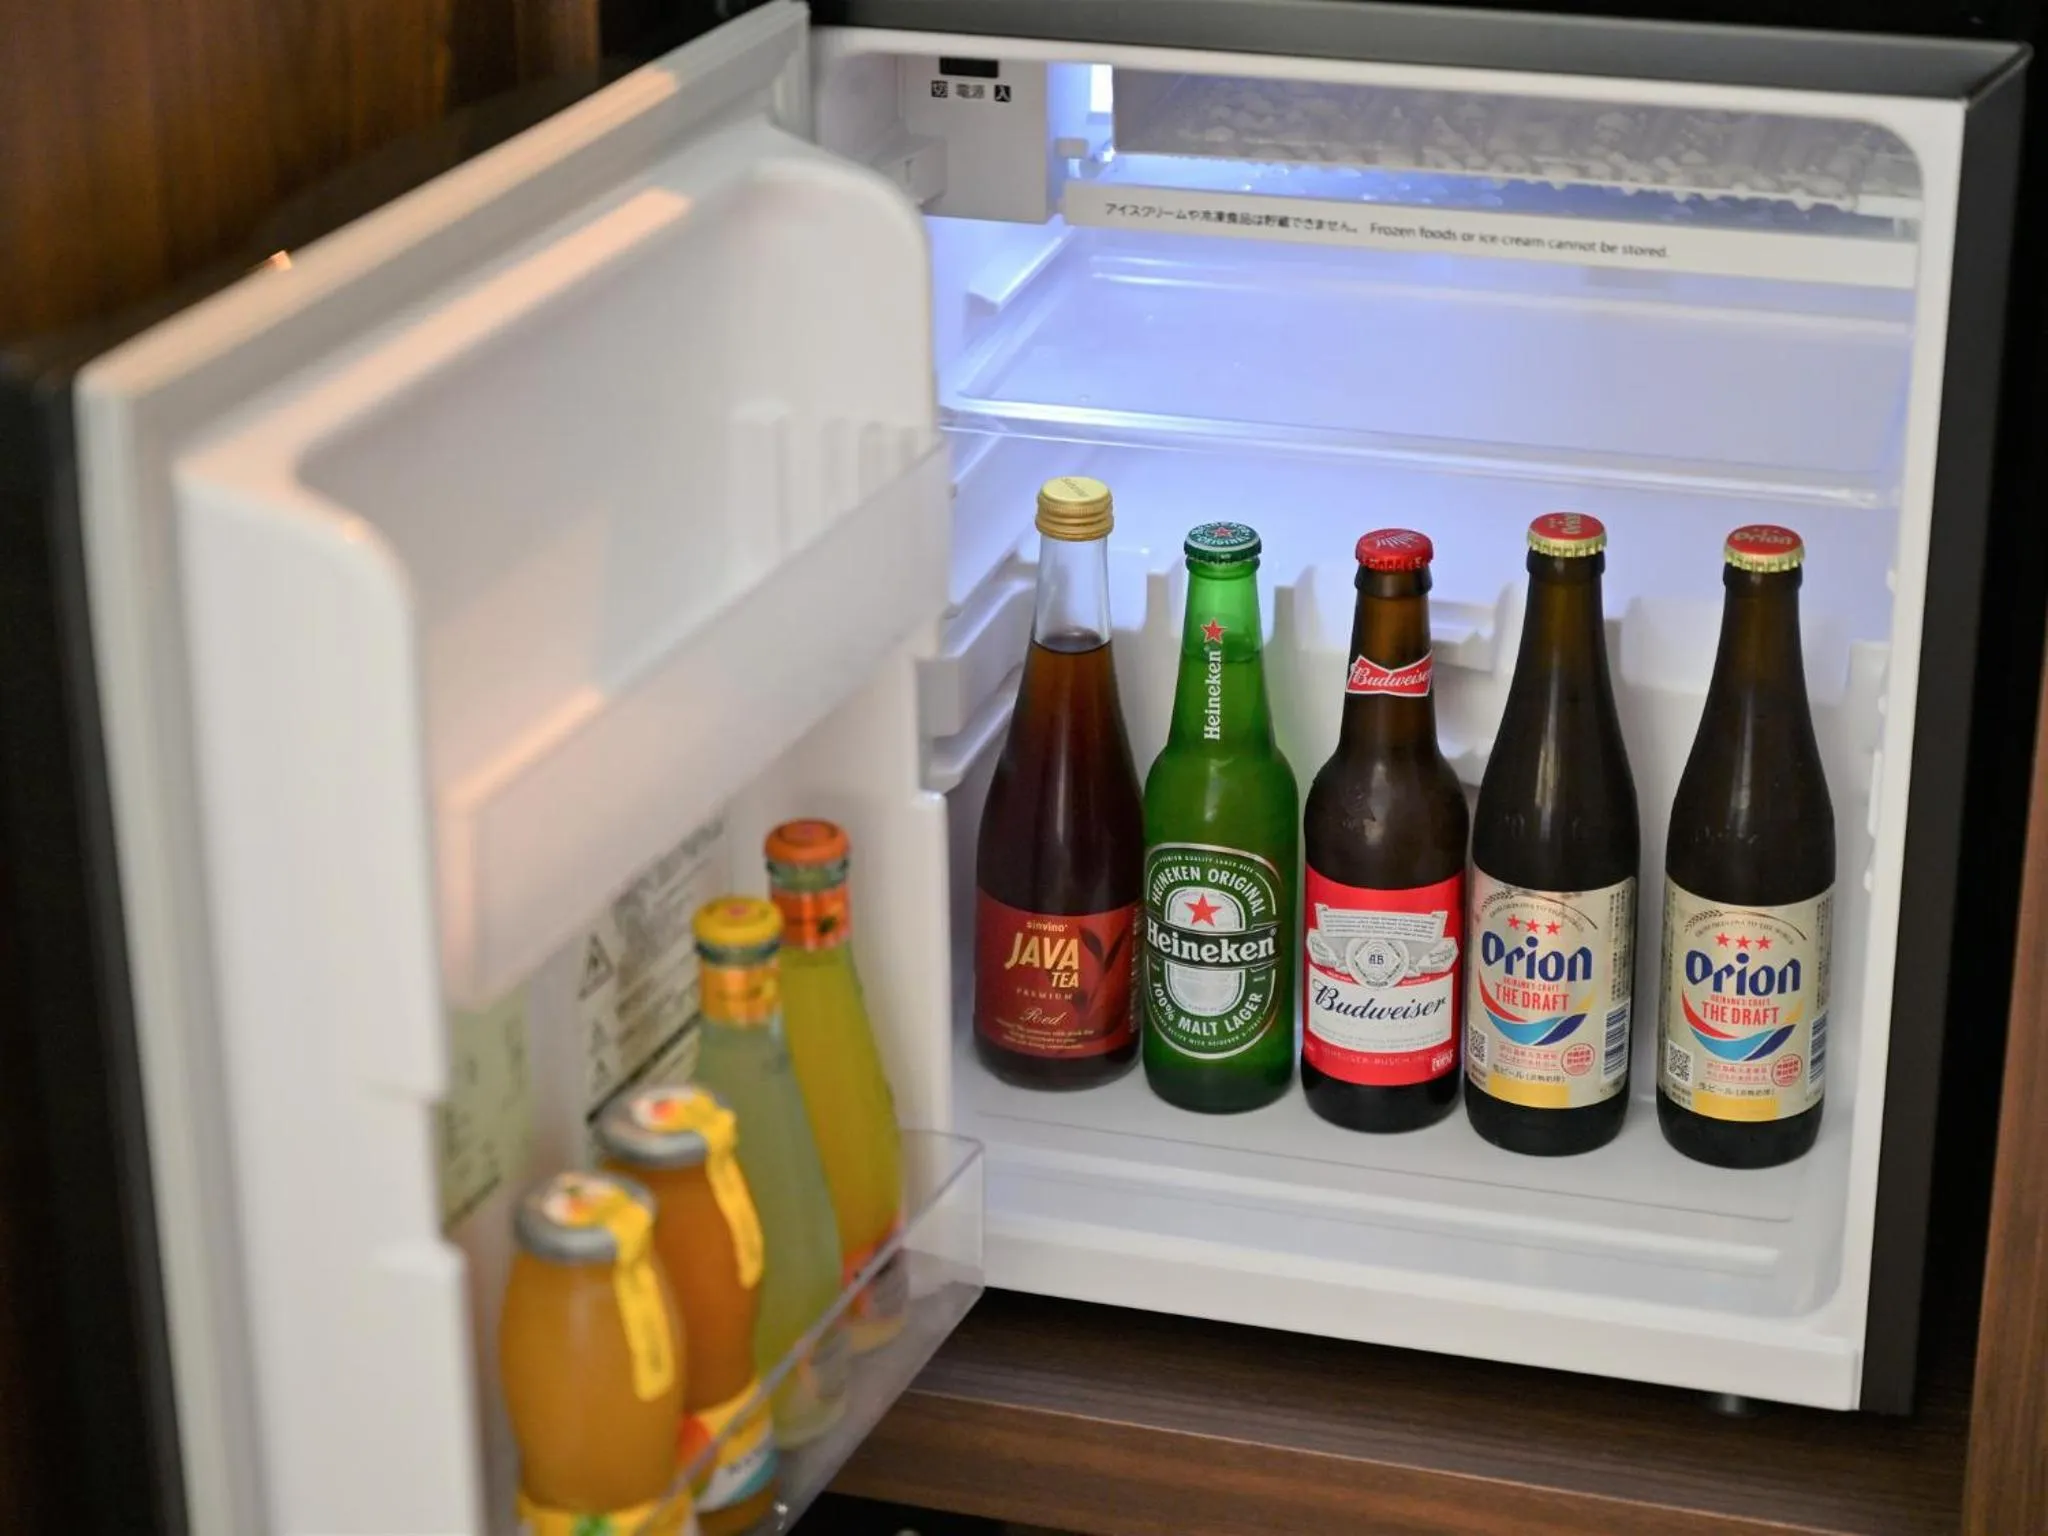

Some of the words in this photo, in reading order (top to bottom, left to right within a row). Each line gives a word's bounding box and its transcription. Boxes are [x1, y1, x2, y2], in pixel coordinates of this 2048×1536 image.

[995, 85, 1012, 102] 入
[1370, 222, 1416, 238] Frozen
[1419, 226, 1458, 241] foods
[1461, 231, 1475, 242] or
[1479, 231, 1499, 244] ice
[1501, 235, 1546, 249] cream
[1548, 238, 1598, 252] cannot
[1601, 241, 1618, 253] be
[1621, 244, 1669, 259] stored.
[1204, 650, 1221, 740] Heineken
[1152, 866, 1200, 906] HEINEKEN
[1207, 868, 1266, 917] ORIGINAL
[1004, 932, 1080, 970] JAVA
[1147, 918, 1276, 964] Heineken
[1481, 930, 1593, 982] Orion
[1051, 971, 1080, 988] TEA
[1685, 949, 1802, 997] Orion
[1016, 987, 1073, 1001] PREMIUM
[1152, 982, 1175, 1020] 100%
[1178, 1016, 1218, 1037] MALT
[1224, 992, 1263, 1033] LAGER
[1312, 979, 1447, 1021] Budweiser
[1494, 983, 1520, 1008] THE
[1521, 992, 1570, 1013] DRAFT
[1702, 1000, 1728, 1024] THE
[1731, 1006, 1780, 1026] DRAFT
[1020, 1007, 1067, 1026] Red
